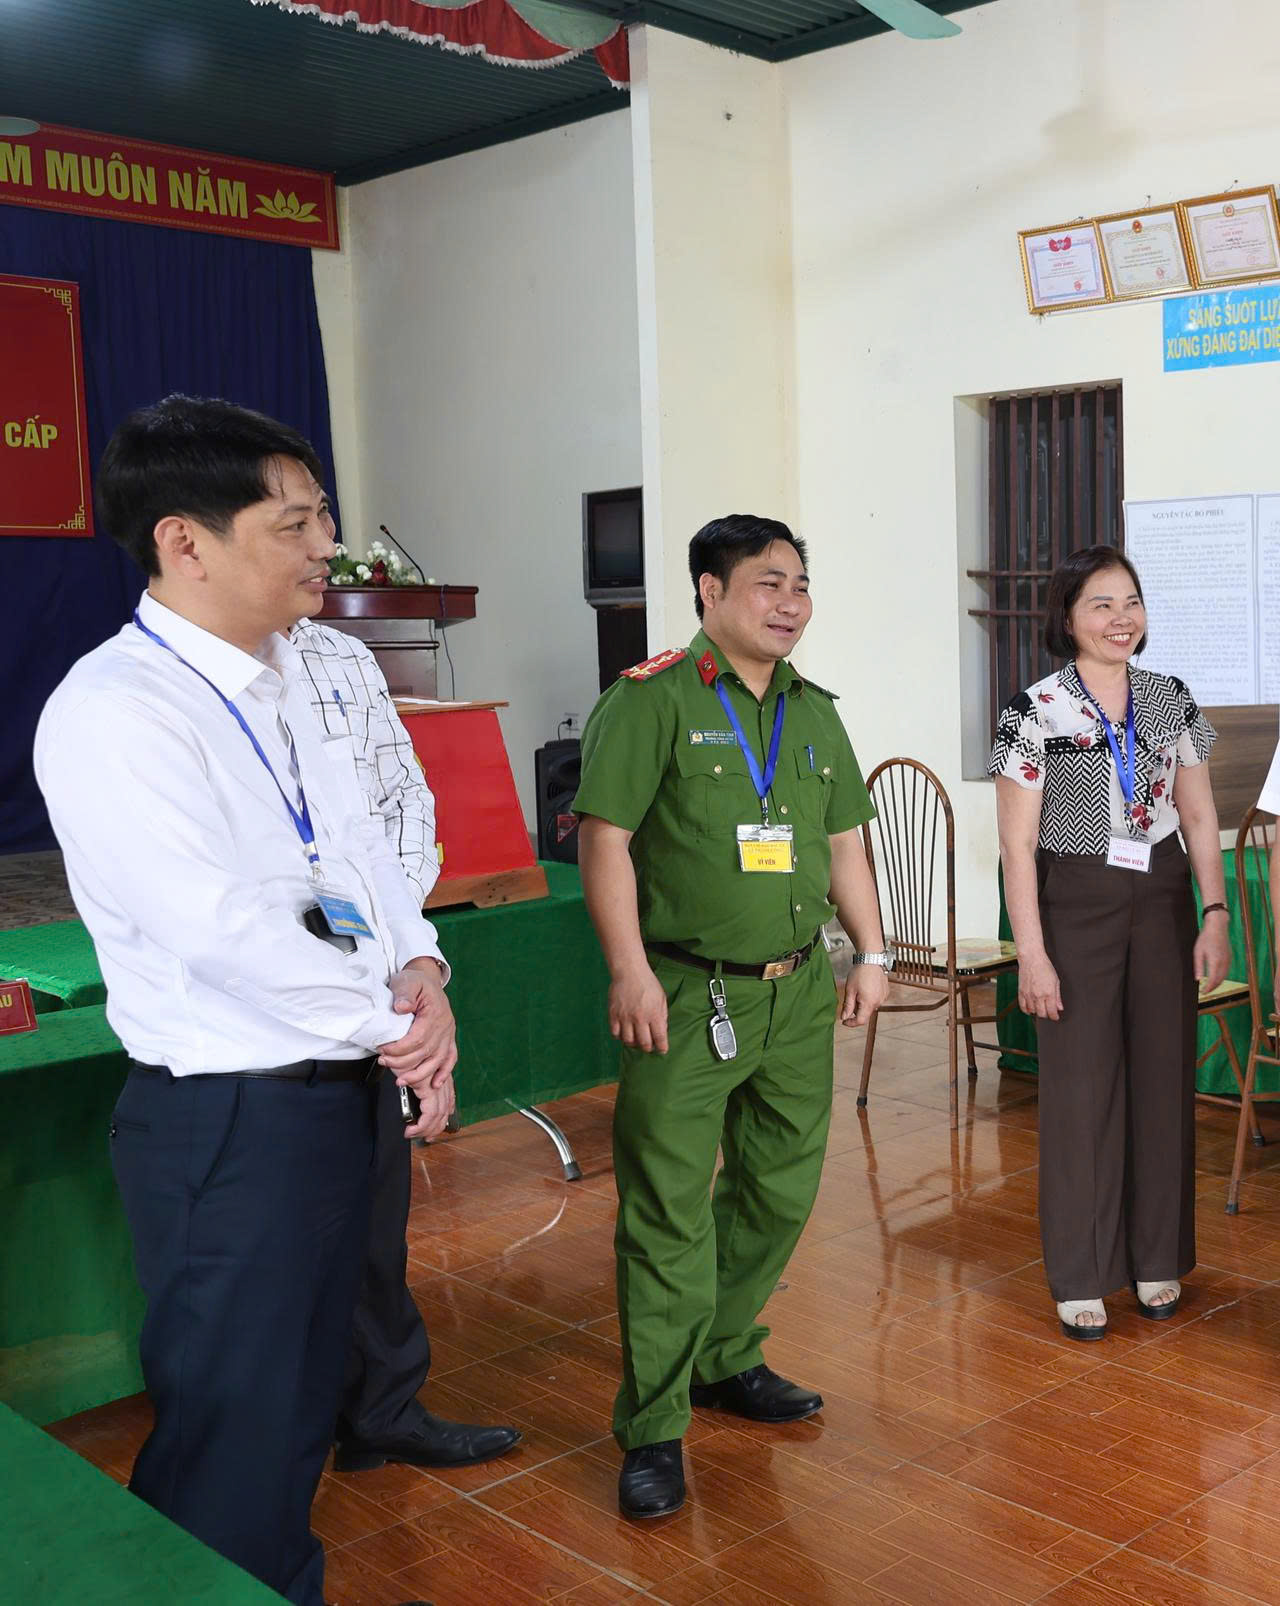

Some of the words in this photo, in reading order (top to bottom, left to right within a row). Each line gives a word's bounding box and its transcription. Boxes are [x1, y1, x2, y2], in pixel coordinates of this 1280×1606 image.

[45, 149, 157, 206] MUÔN
[169, 167, 249, 219] NĂM
[1167, 332, 1200, 359] XỨNG
[1202, 328, 1236, 356] ĐÁNG
[1239, 328, 1260, 356] ĐẠI
[4, 414, 58, 449] CẤP
